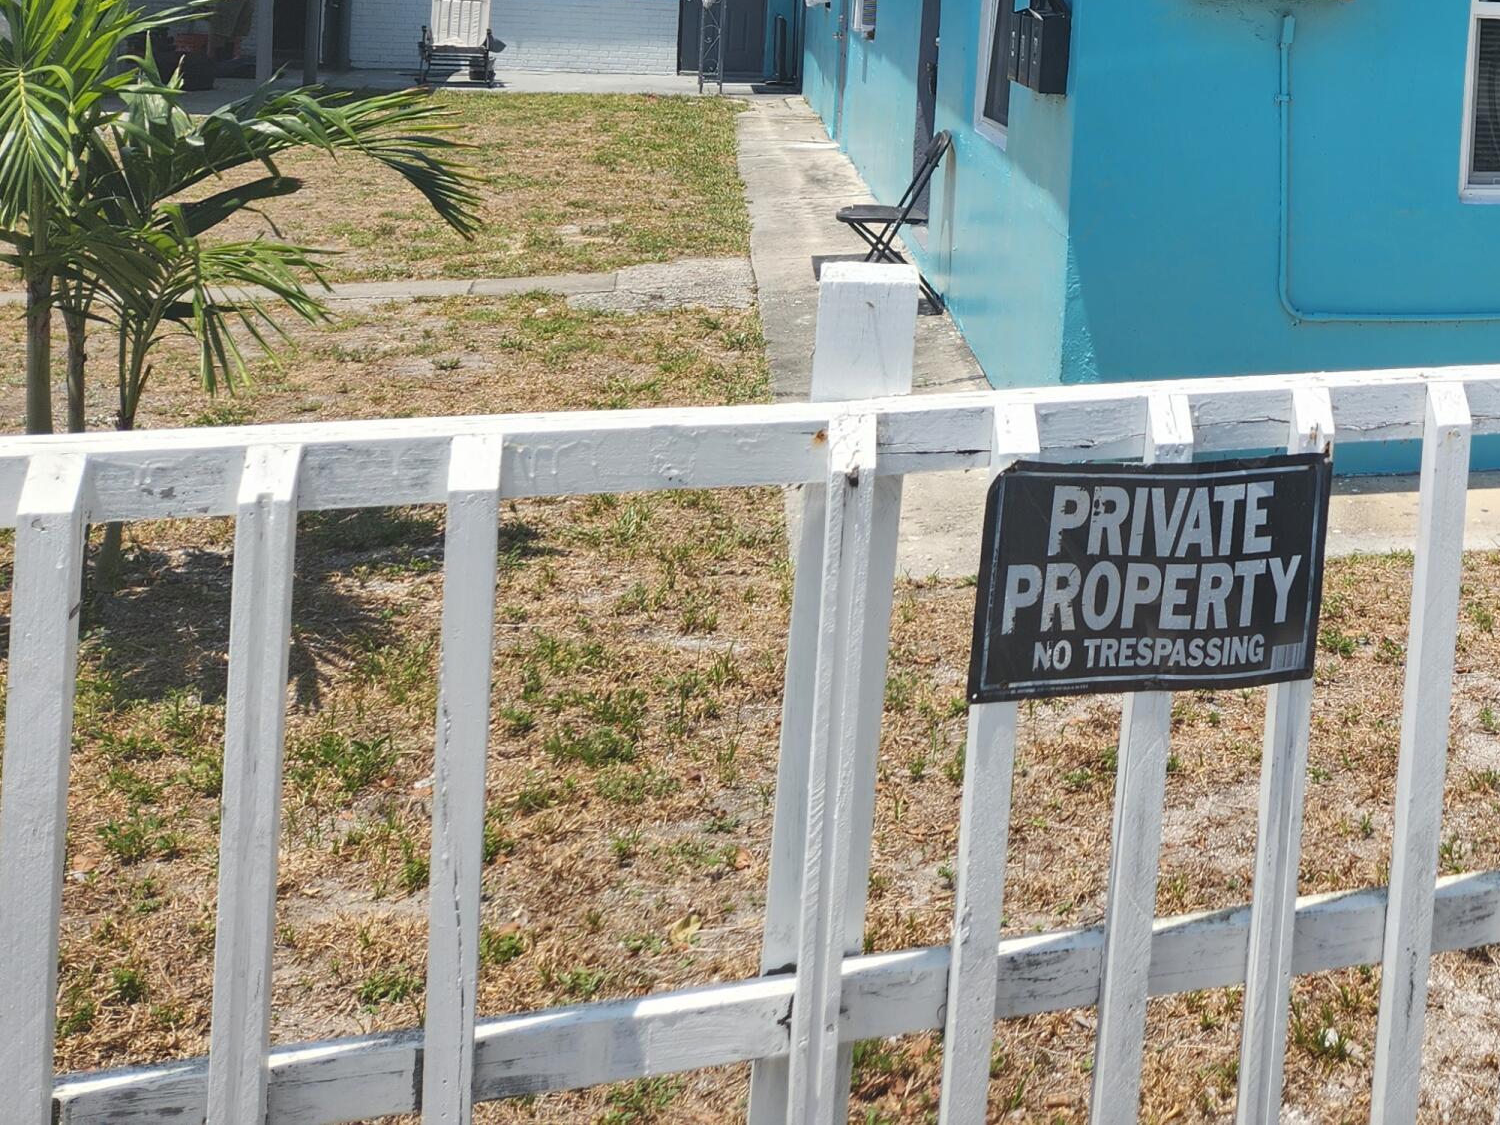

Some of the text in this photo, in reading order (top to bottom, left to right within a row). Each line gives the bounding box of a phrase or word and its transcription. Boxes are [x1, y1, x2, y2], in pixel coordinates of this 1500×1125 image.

[1047, 480, 1275, 558] PRIVATE
[1001, 554, 1303, 636] PROPERTY
[1032, 633, 1265, 672] NO TRESPASSING
